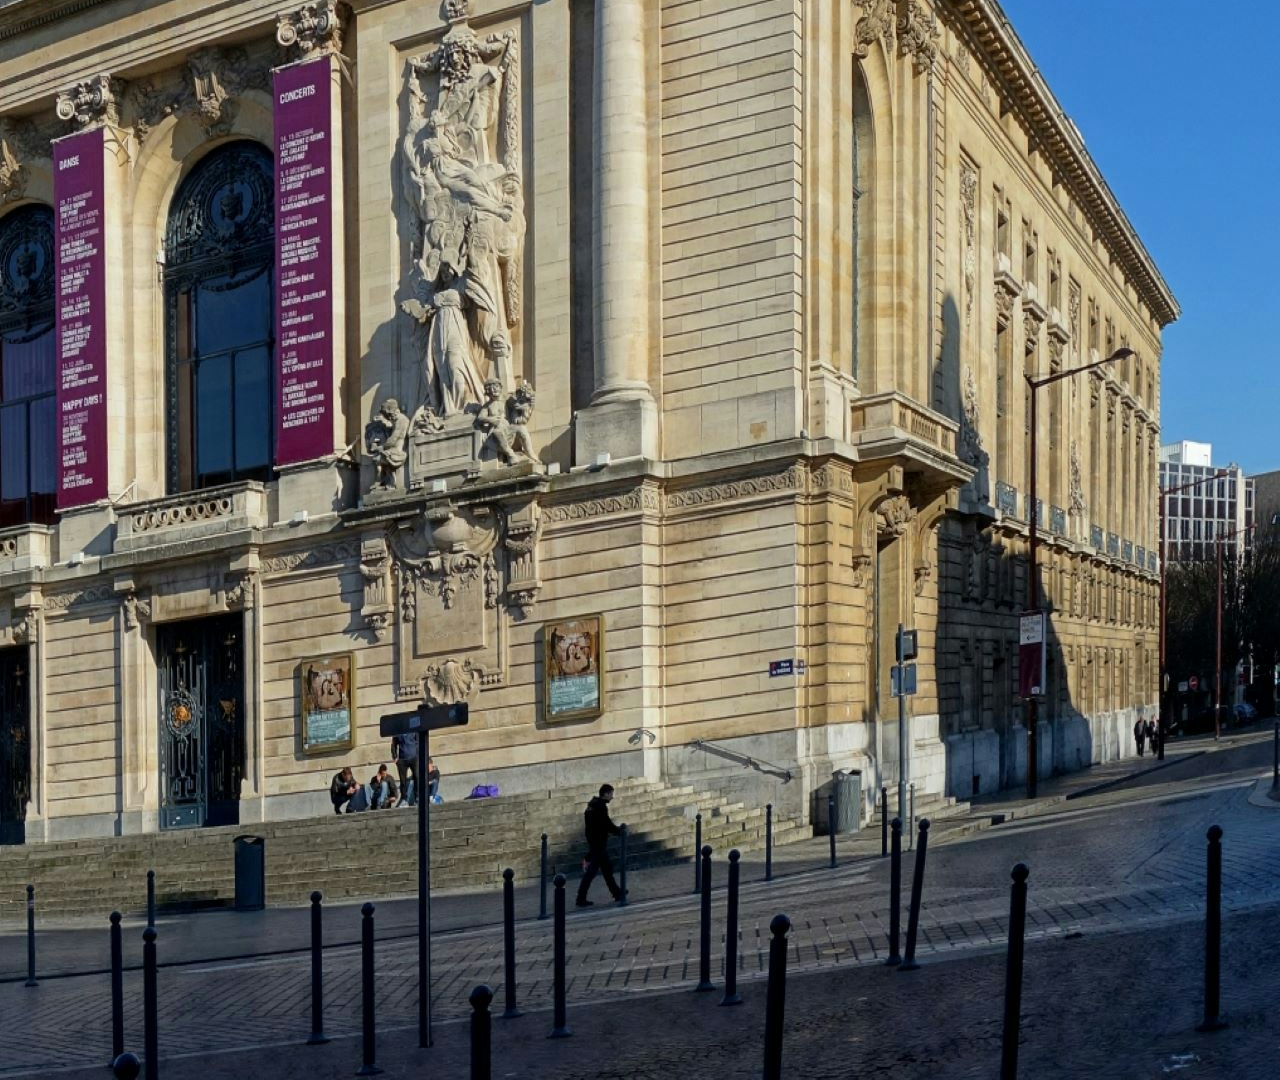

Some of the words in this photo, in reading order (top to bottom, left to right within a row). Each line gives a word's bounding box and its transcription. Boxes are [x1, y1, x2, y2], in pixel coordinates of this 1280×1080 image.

[280, 85, 315, 104] CONCERTS
[59, 155, 79, 170] DANSE
[63, 398, 82, 411] HAPPY
[84, 395, 98, 406] DAYS
